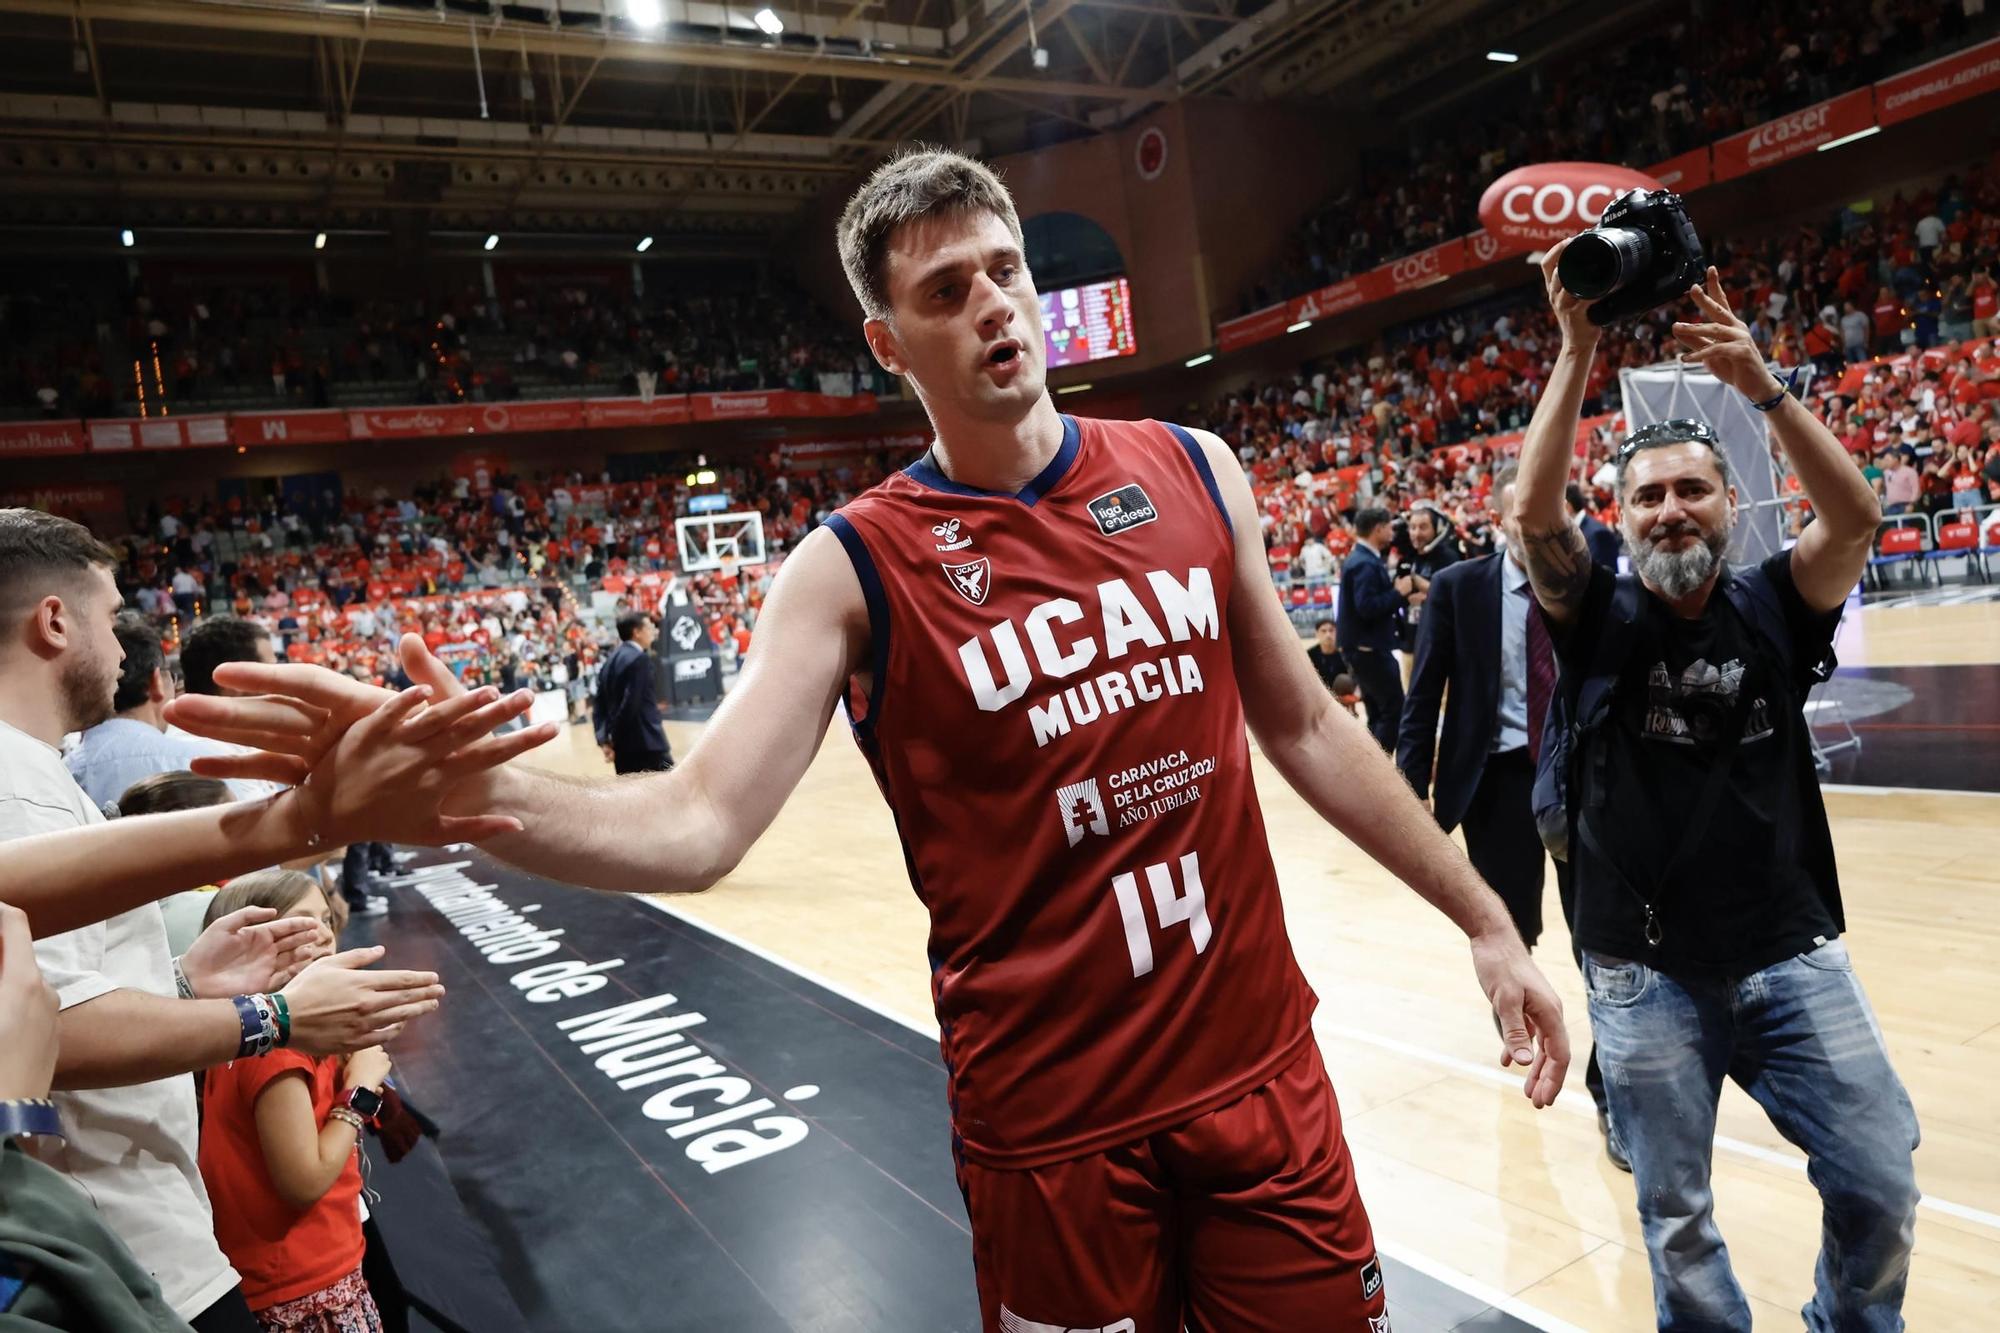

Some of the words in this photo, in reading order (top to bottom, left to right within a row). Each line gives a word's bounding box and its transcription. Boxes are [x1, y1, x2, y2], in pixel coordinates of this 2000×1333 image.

[1603, 207, 1628, 224] Nikon
[1098, 504, 1123, 521] liga
[1105, 506, 1152, 529] endesa
[935, 536, 973, 552] hummel
[955, 564, 980, 576] UCAM
[957, 566, 1220, 712] UCAM
[1027, 654, 1205, 748] MURCIA
[1108, 750, 1189, 789] CARAVACA
[1113, 790, 1133, 808] DE
[1135, 787, 1153, 801] LA
[1153, 770, 1190, 793] CRUZ
[1119, 804, 1148, 828] AÑO
[1150, 785, 1202, 819] JUBILAR
[1111, 851, 1213, 979] 14
[509, 958, 625, 1003] de
[556, 993, 820, 1175] Murcia
